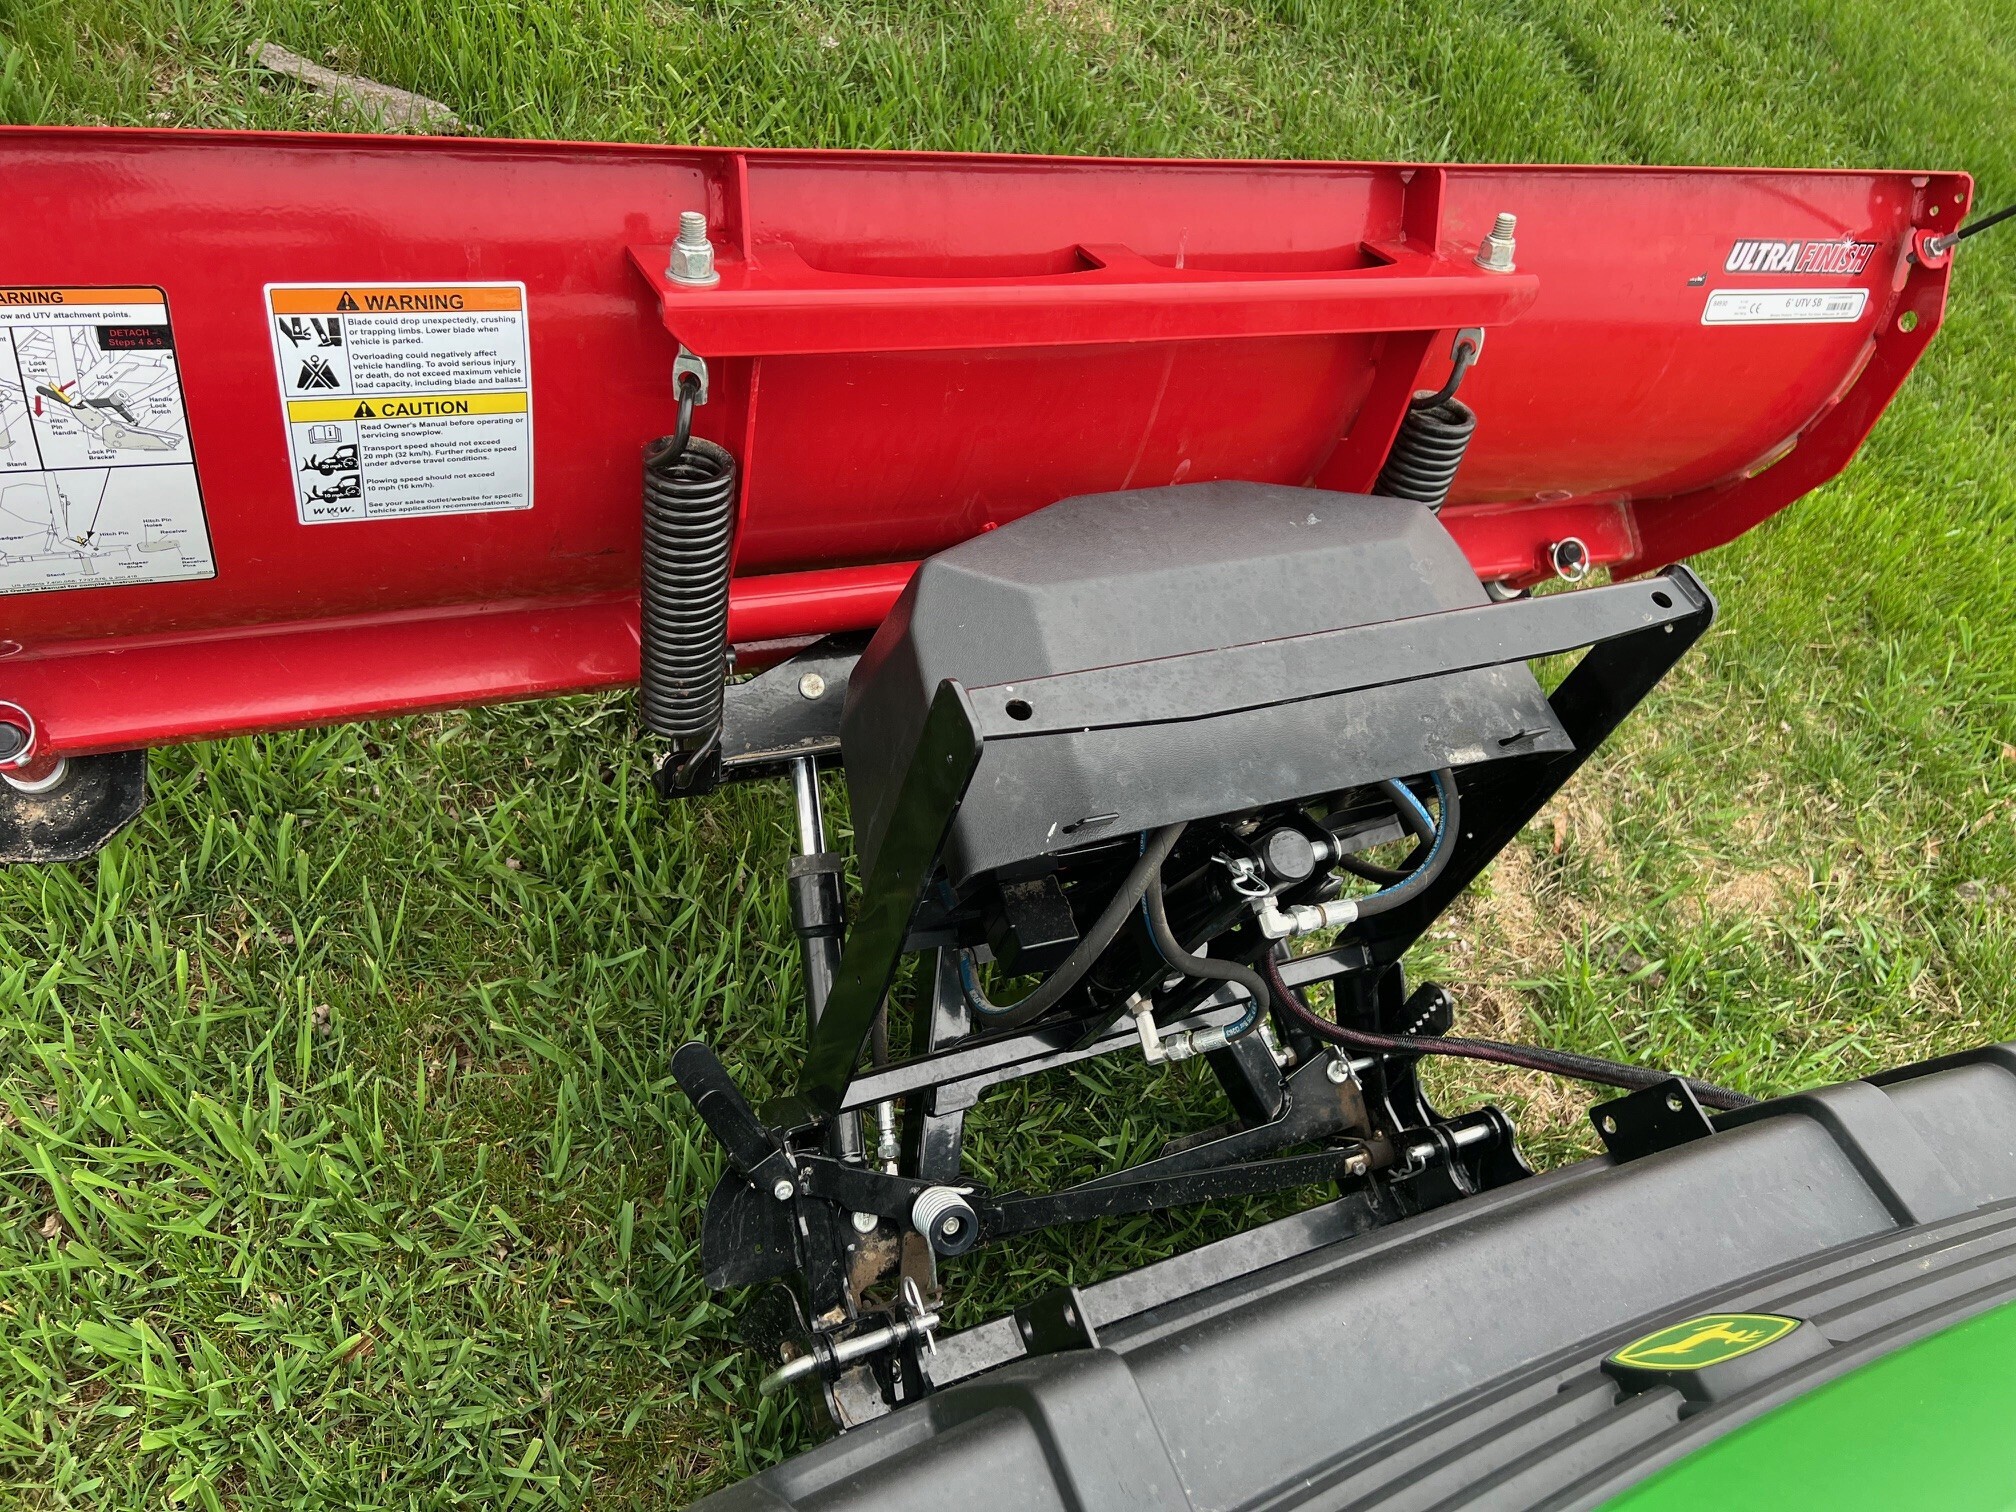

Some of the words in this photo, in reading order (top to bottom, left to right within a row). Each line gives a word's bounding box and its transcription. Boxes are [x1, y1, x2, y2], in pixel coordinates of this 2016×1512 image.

[1725, 242, 1800, 272] ULTRA
[1796, 243, 1875, 273] FINISH
[364, 294, 464, 311] WARNING
[1795, 298, 1813, 307] UTV
[1812, 298, 1822, 307] SB
[102, 311, 131, 319] points.
[400, 317, 420, 327] drop
[422, 316, 479, 325] unexpectedly,
[480, 316, 516, 325] crushing
[109, 329, 150, 337] DETACH
[360, 327, 396, 338] trapping
[109, 338, 136, 347] Steps
[350, 337, 380, 345] vehicle
[392, 336, 423, 346] parked.
[352, 352, 403, 362] Overloading
[430, 351, 471, 360] negatively
[353, 362, 383, 370] vehicle
[385, 360, 424, 370] handling.
[493, 358, 516, 368] injury
[365, 371, 392, 380] death,
[376, 380, 413, 389] capacity,
[414, 378, 452, 388] including
[382, 400, 468, 417] CAUTION
[477, 418, 513, 427] operating
[361, 431, 399, 440] servicing
[400, 429, 443, 438] snowplow.
[363, 444, 402, 453] Transport
[403, 442, 426, 450] speed
[375, 452, 393, 460] mph
[395, 450, 407, 459] (32
[409, 449, 433, 458] km/h).
[366, 477, 398, 486] Plowing
[400, 476, 423, 484] speed
[426, 496, 480, 504] outlet/website
[312, 505, 355, 515] www.
[398, 505, 441, 514] application
[442, 501, 512, 509] recommendations.
